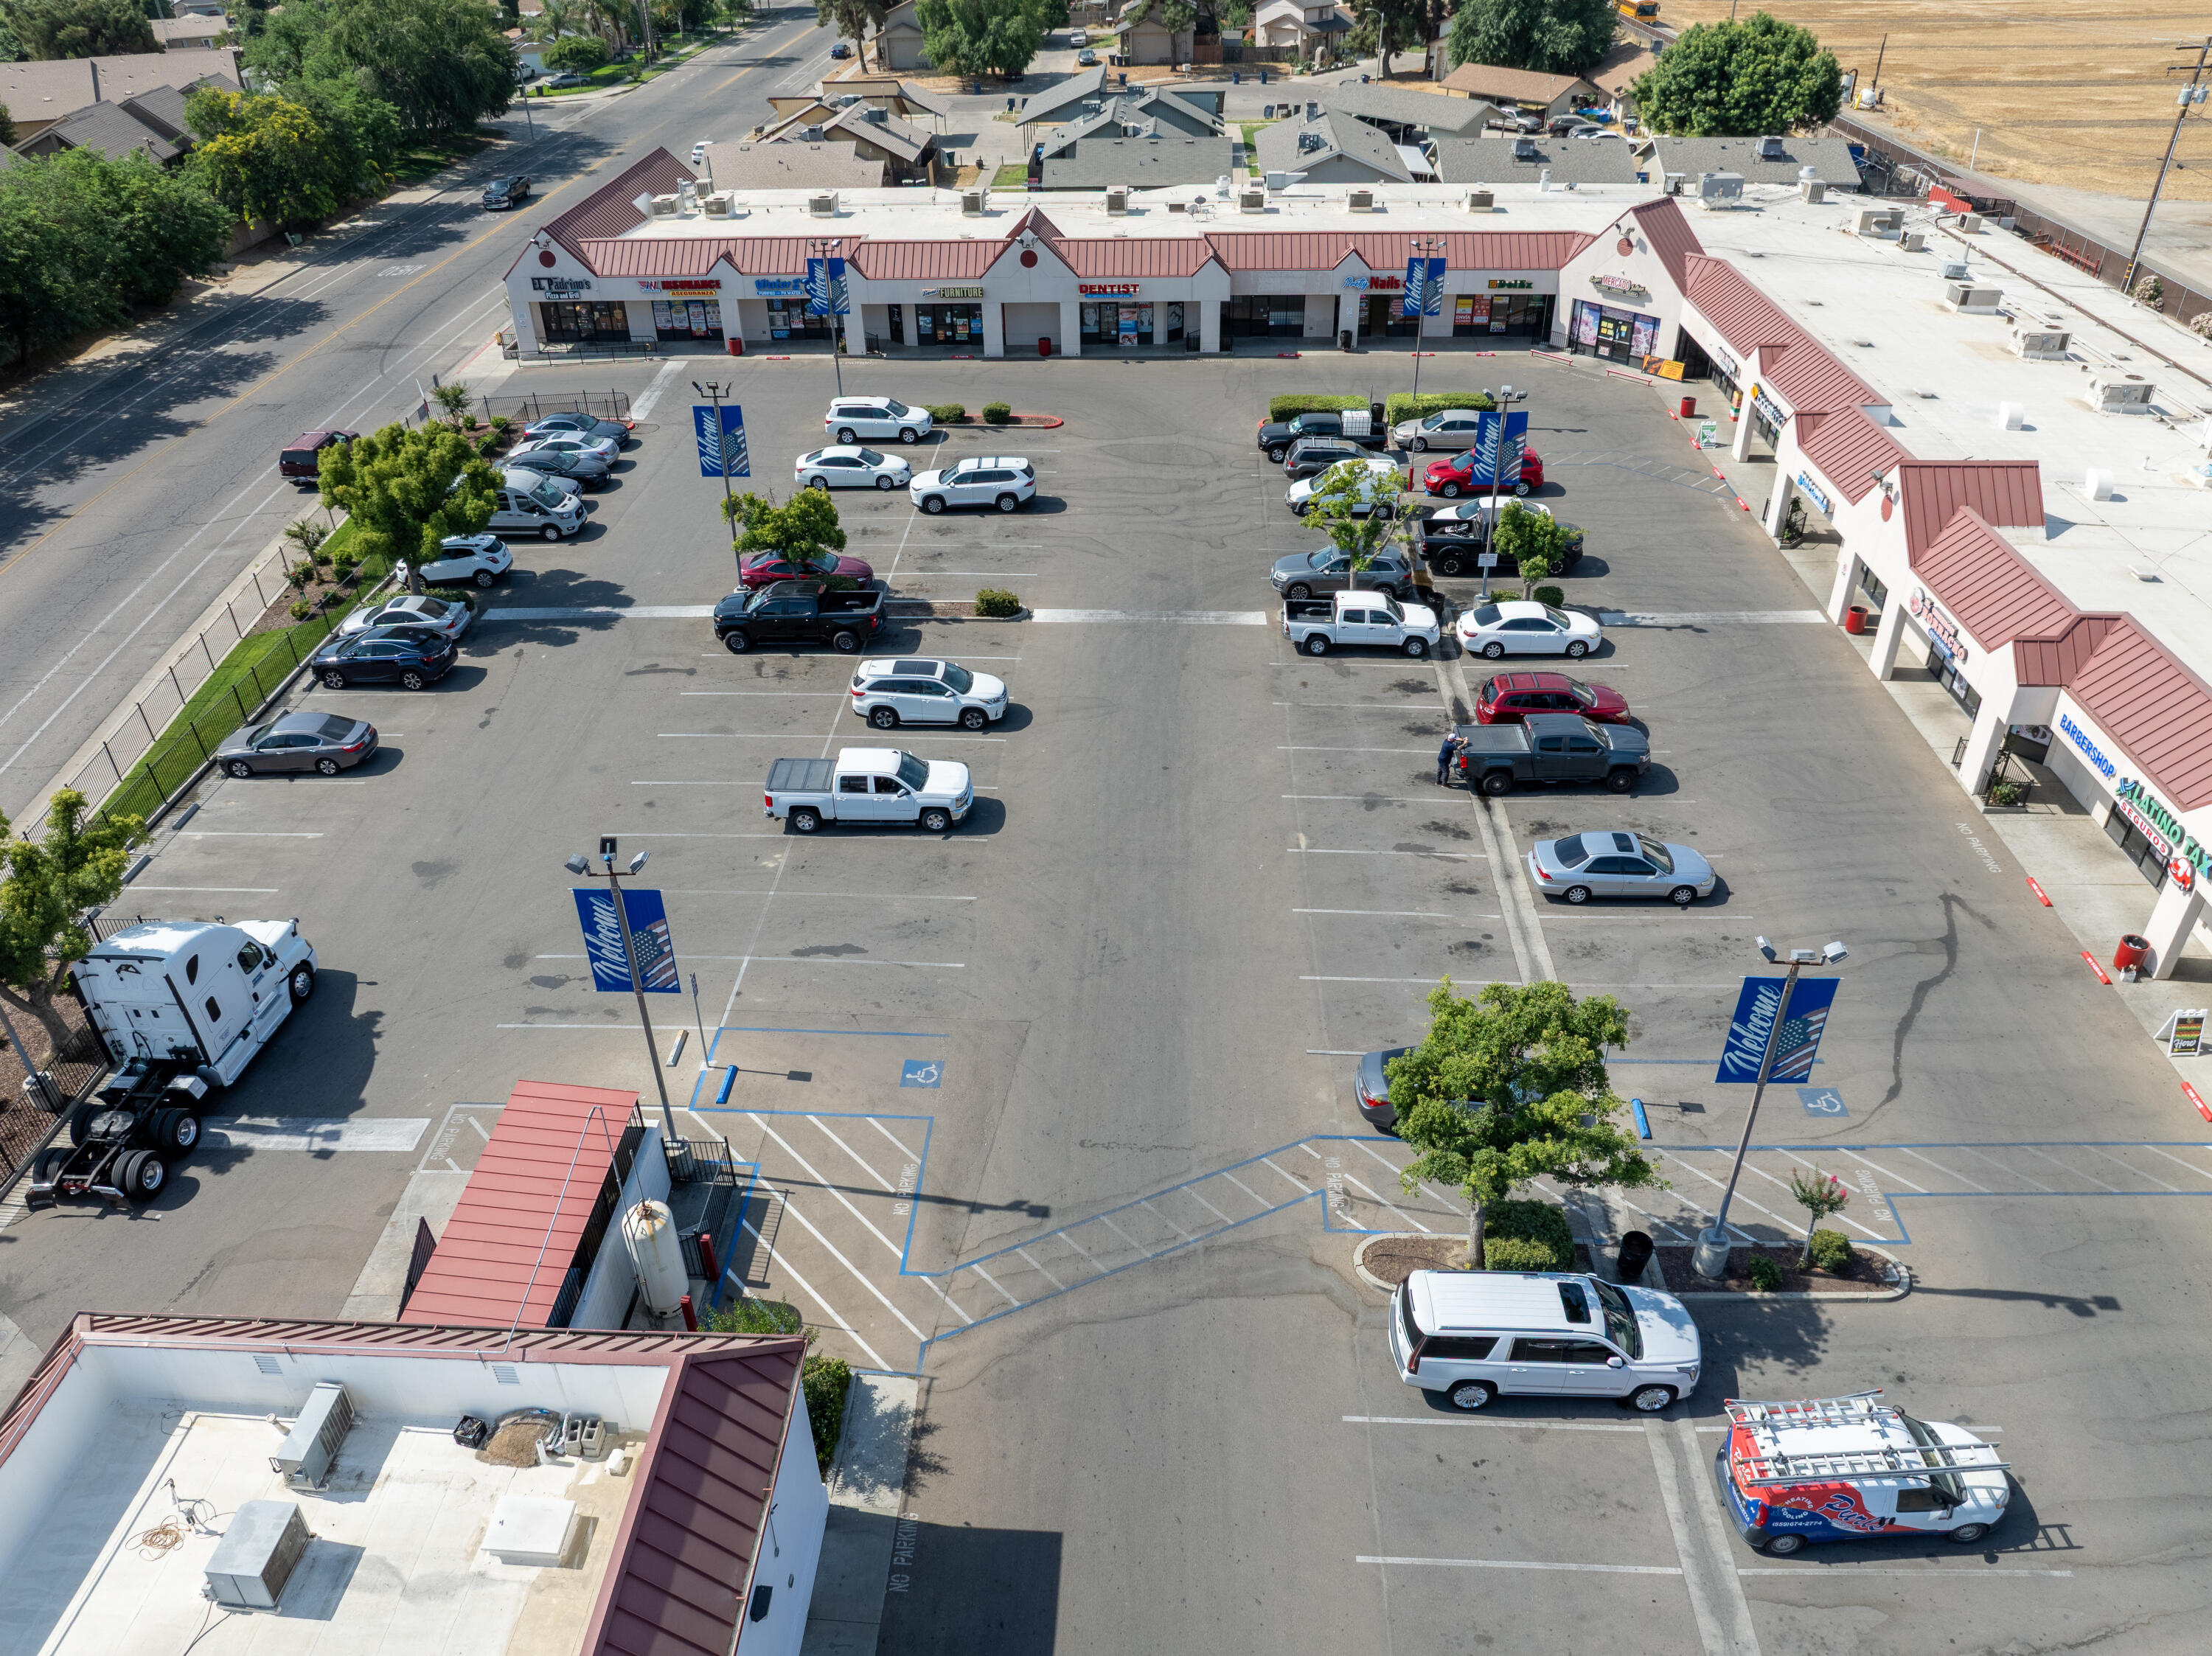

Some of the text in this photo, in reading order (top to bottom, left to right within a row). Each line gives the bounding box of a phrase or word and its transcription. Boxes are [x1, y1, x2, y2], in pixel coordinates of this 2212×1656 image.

[661, 279, 722, 290] INSURANCE
[755, 279, 790, 290] Water
[810, 262, 828, 310] Welcome
[940, 287, 983, 298] FURNITURE
[1079, 284, 1139, 294] DENTIST
[1343, 276, 1369, 291] Pretty
[1370, 275, 1400, 289] Nails
[1405, 261, 1424, 310] Welcome
[1601, 276, 1631, 291] MERCADO
[698, 411, 723, 472] Welcome
[1475, 417, 1500, 479] Welcome
[2060, 714, 2115, 778] BARBERSHOP
[1955, 822, 2002, 874] NO PARKING
[2121, 801, 2166, 854] SEGUROS
[2132, 785, 2212, 880] LATINO TAX
[585, 896, 631, 984] Welcome
[1724, 984, 1781, 1075] Welcome
[2174, 1039, 2196, 1048] Here
[430, 1113, 468, 1161] NO PARKING
[893, 1163, 919, 1215] NO PARKING
[1324, 1157, 1344, 1208] NO PARKING
[1854, 1169, 1893, 1221] NO PARKING
[1781, 1508, 1809, 1520] COOLING
[1785, 1496, 1814, 1509] HEATING
[888, 1512, 919, 1593] NO PARKING
